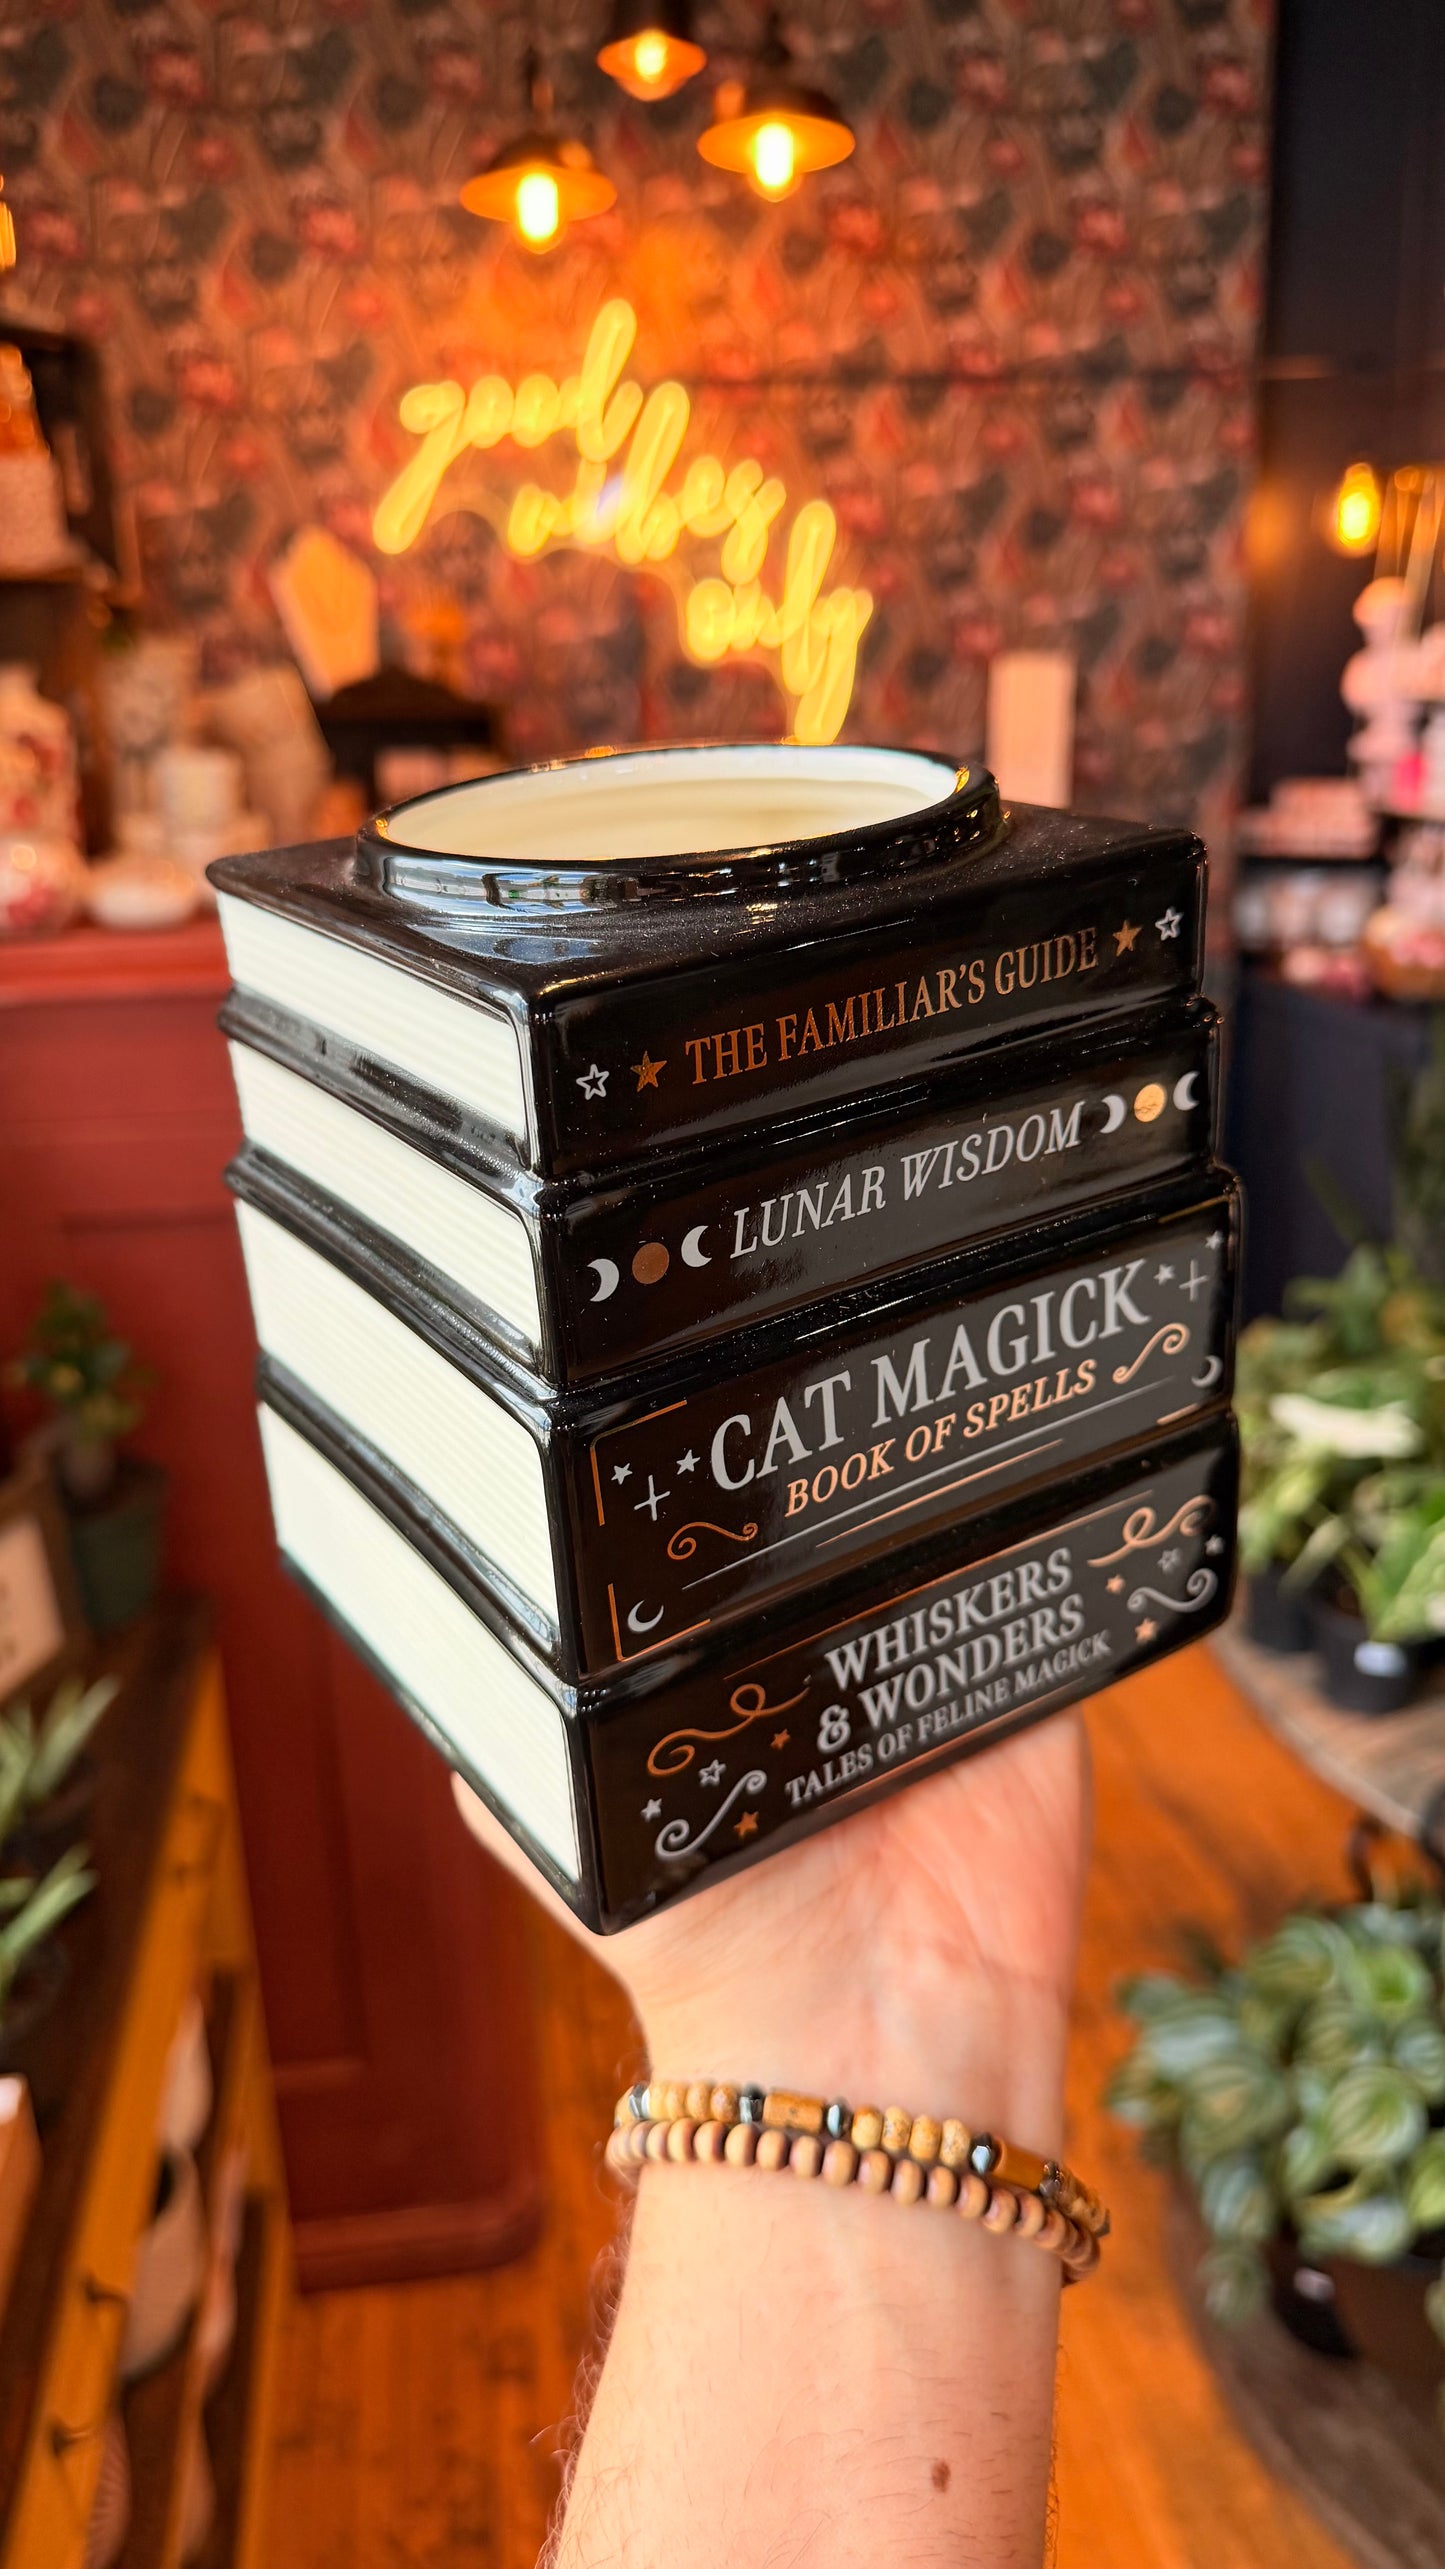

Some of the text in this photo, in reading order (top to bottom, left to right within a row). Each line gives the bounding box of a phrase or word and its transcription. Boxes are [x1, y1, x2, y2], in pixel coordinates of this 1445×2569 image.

[685, 927, 1099, 1085] THE FAMILIAR'S GUIDE
[729, 1100, 1087, 1259] LUNAR WISDOM
[710, 1258, 1152, 1492] CAT MAGICK
[784, 1358, 1097, 1519] BOOK OF SPELLS
[816, 1592, 1086, 1754] & WONDERS
[824, 1547, 1074, 1691] WHISKERS
[784, 1630, 1112, 1805] TALES OF FELINE MAGICK
